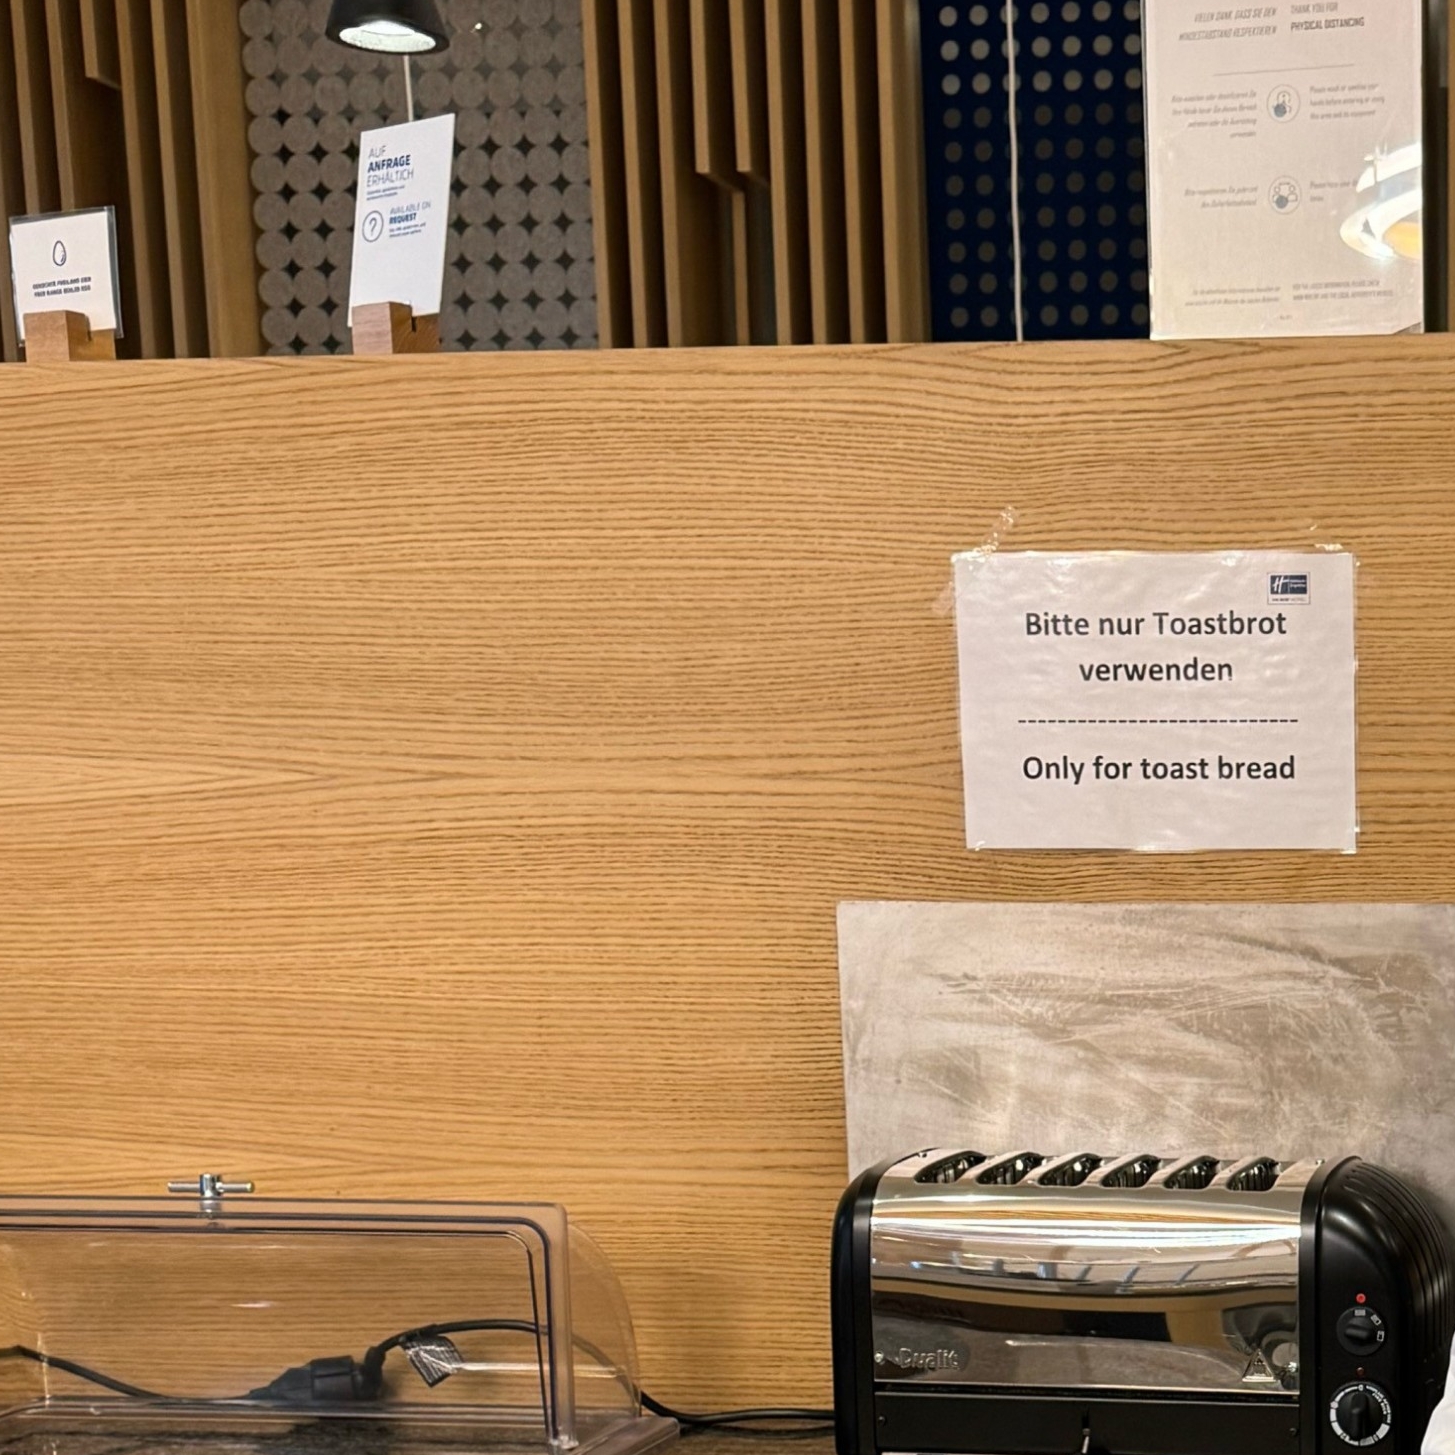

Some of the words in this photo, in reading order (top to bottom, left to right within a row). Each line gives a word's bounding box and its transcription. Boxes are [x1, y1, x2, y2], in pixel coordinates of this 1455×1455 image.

[1290, 20, 1323, 32] PHYSICAL
[1324, 17, 1365, 30] DISTANCING
[368, 145, 386, 159] AUF
[367, 154, 411, 173] ANFRAGE
[388, 212, 417, 225] REQUEST
[1025, 611, 1089, 636] Bitte
[1099, 617, 1145, 636] nur
[1152, 609, 1288, 636] Toastbrot
[1079, 656, 1233, 682] verwenden
[1022, 755, 1084, 785] Only
[1092, 755, 1133, 780] for
[1140, 757, 1209, 780] toast
[1218, 754, 1296, 780] bread
